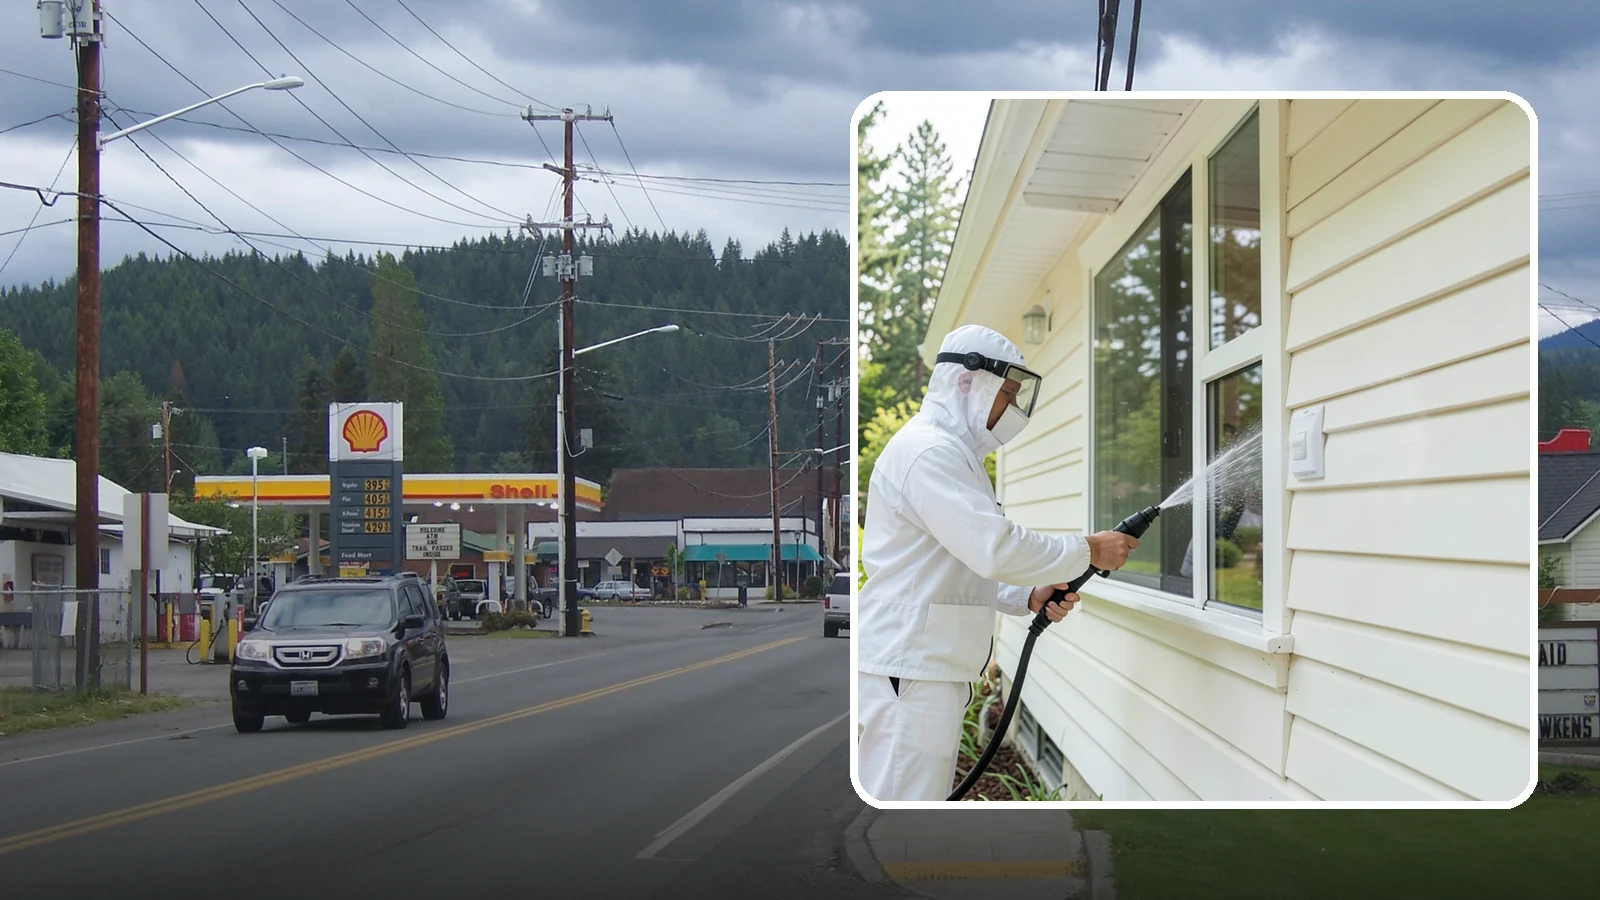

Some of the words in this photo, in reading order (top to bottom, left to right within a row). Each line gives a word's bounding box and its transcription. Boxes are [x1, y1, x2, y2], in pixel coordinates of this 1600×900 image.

[366, 480, 383, 490] 395
[490, 484, 547, 499] Shell
[366, 495, 383, 504] 405
[366, 508, 383, 518] 415
[366, 522, 383, 532] 429
[1538, 643, 1566, 665] AID
